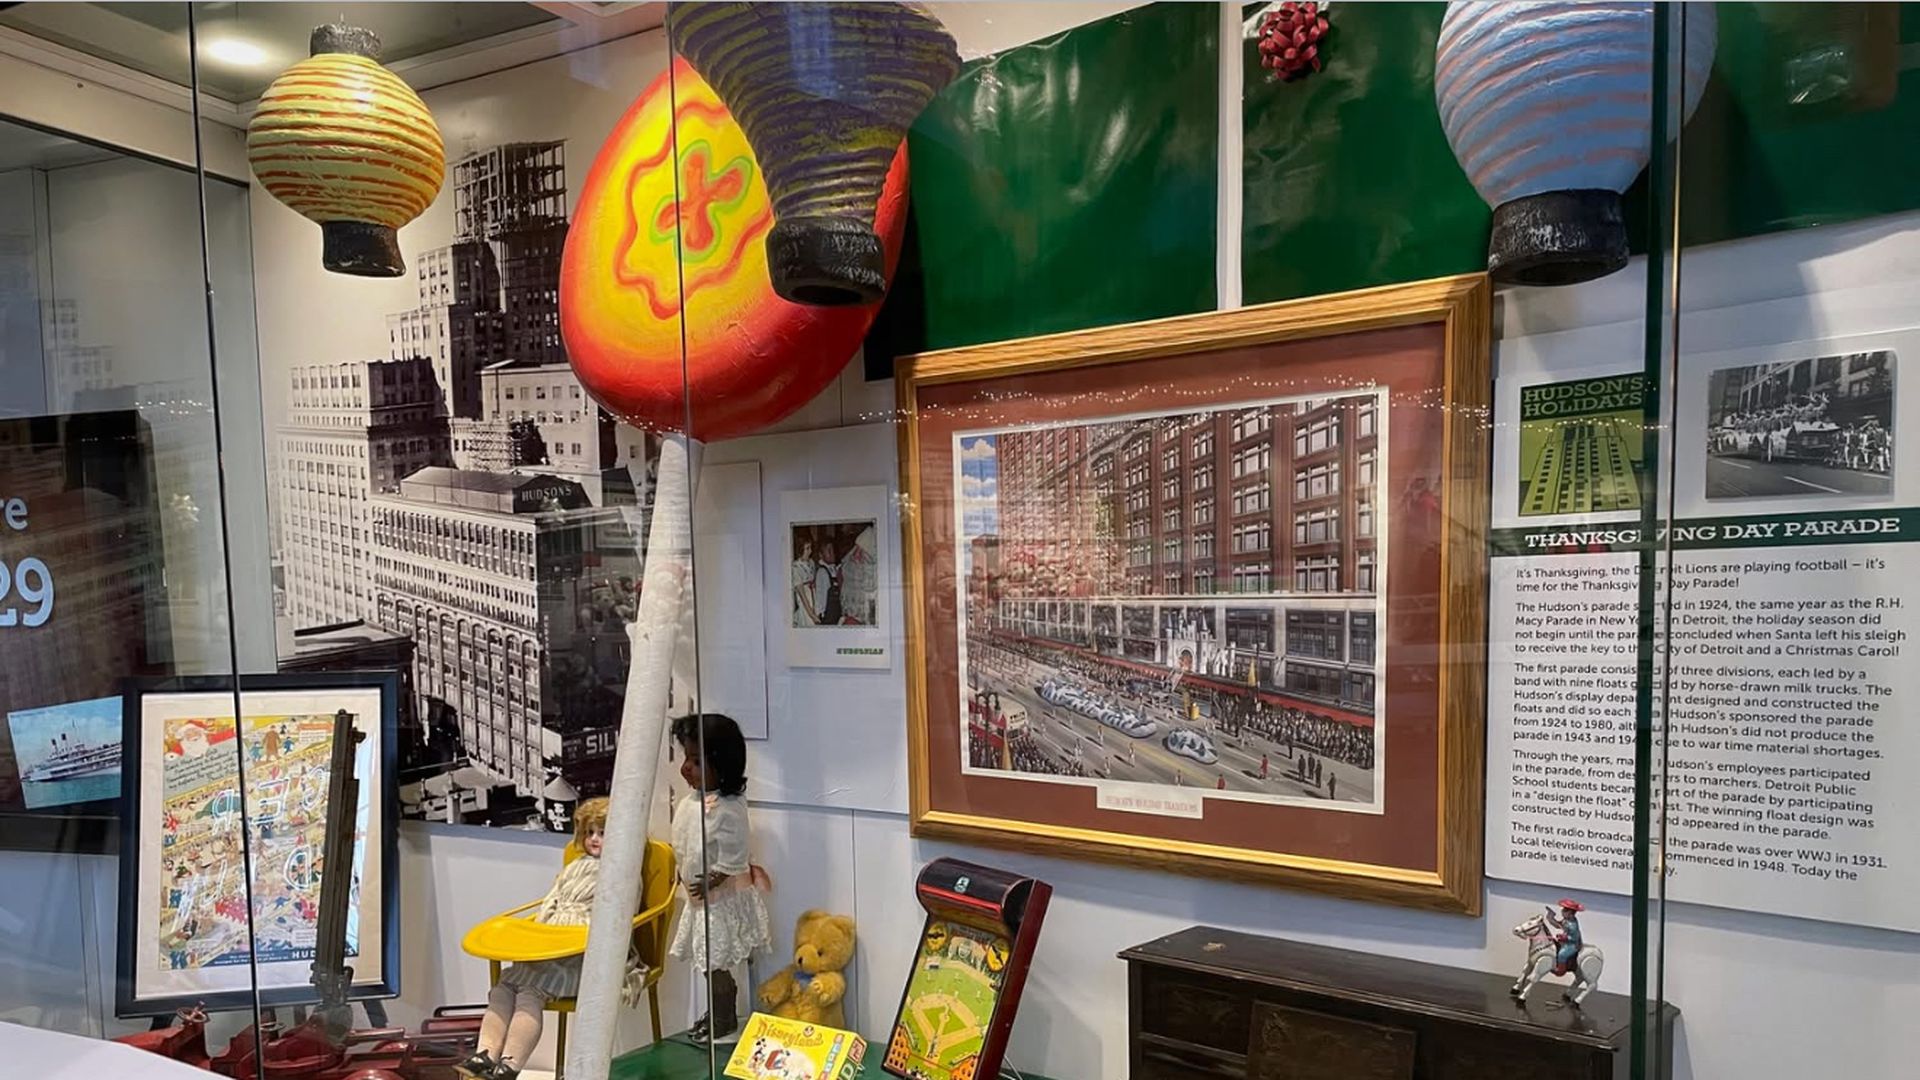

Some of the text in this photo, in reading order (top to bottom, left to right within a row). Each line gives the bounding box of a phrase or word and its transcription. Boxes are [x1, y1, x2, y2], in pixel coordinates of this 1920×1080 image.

[1523, 376, 1643, 402] HUDSON'S
[1523, 392, 1642, 417] HOLIDAYS
[1723, 522, 1777, 540] DAY
[1783, 517, 1900, 537] PARADE
[1516, 568, 1530, 578] It's
[1611, 565, 1629, 576] the
[1685, 562, 1717, 573] Lions
[1720, 564, 1740, 572] are
[1743, 561, 1790, 574] playing
[1794, 560, 1847, 571] football
[1865, 559, 1885, 570] it's
[1516, 581, 1540, 591] time
[1542, 581, 1558, 591] for
[1560, 580, 1578, 591] the
[1515, 601, 1535, 612] The
[1538, 601, 1588, 612] Hudson's
[1590, 601, 1630, 614] parade
[1735, 599, 1756, 609] the
[1760, 601, 1793, 609] same
[1798, 601, 1825, 611] year
[1848, 599, 1871, 609] the
[1514, 615, 1544, 627] Macy
[1545, 615, 1583, 625] Parade
[1599, 615, 1626, 625] New
[1731, 614, 1753, 624] the
[1756, 614, 1804, 626] holiday
[1807, 616, 1855, 624] season
[1858, 614, 1881, 624] did
[1514, 629, 1906, 642] not begin until the concluded when Santa left his sleigh
[1528, 643, 1567, 653] receive
[1569, 643, 1587, 653] the
[1590, 643, 1610, 655] key
[1700, 644, 1742, 655] Detroit
[1746, 645, 1770, 655] and
[1786, 645, 1852, 656] Christmas
[1514, 662, 1533, 673] The
[1537, 663, 1556, 673] first
[1560, 664, 1597, 676] parade
[1680, 665, 1713, 676] three
[1777, 668, 1810, 678] each
[1813, 668, 1834, 678] led
[1837, 668, 1855, 681] by
[1513, 676, 1540, 687] band
[1542, 677, 1566, 687] with
[1569, 677, 1593, 688] nine
[1596, 678, 1627, 689] floats
[1681, 680, 1695, 693] by
[1699, 681, 1779, 693] horse-drawn
[1784, 683, 1810, 693] milk
[1866, 684, 1892, 695] The
[1513, 690, 1879, 711] Hudson's display designed and constructed the
[1513, 703, 1874, 728] floats and did each Hudson's sponsored the parade
[1513, 716, 1538, 727] from
[1541, 717, 1567, 728] 1924
[1680, 723, 1737, 736] Hudson's
[1740, 726, 1761, 737] did
[1764, 728, 1787, 738] not
[1790, 730, 1847, 741] produce
[1850, 731, 1874, 742] the
[586, 730, 619, 755] SIL
[1513, 731, 1549, 742] parade
[1564, 732, 1591, 743] 1943
[1593, 733, 1615, 743] and
[1698, 741, 1720, 750] war
[1724, 741, 1752, 752] time
[1756, 743, 1808, 755] material
[1513, 749, 1557, 763] Through
[1560, 752, 1578, 763] the
[1716, 763, 1786, 776] employees
[1789, 767, 1870, 781] participated
[1524, 763, 1542, 774] the
[1587, 767, 1615, 778] from
[1764, 779, 1810, 793] Detroit
[1814, 783, 1856, 796] Public
[1512, 775, 1872, 815] School students the parade by participating
[1511, 804, 1576, 817] constructed
[1578, 807, 1592, 820] by
[1681, 818, 1739, 831] appeared
[1758, 823, 1779, 835] the
[1574, 794, 1593, 805] the
[1686, 802, 1709, 814] The
[1712, 805, 1762, 821] winning
[1766, 809, 1795, 822] float
[1799, 812, 1843, 827] design
[1847, 819, 1873, 829] was
[1511, 820, 1531, 832] The
[1533, 823, 1554, 835] first
[1556, 826, 1584, 838] radio
[1668, 836, 1688, 848] the
[1690, 841, 1733, 853] parade
[1736, 845, 1761, 855] was
[1764, 848, 1793, 859] over
[1796, 850, 1831, 862] WWJ
[1510, 850, 1608, 867] parade televised
[1511, 834, 1539, 847] Local
[1542, 837, 1592, 853] television
[1791, 864, 1831, 880] Today
[1835, 869, 1857, 881] the
[752, 1017, 824, 1047] Disneyland
